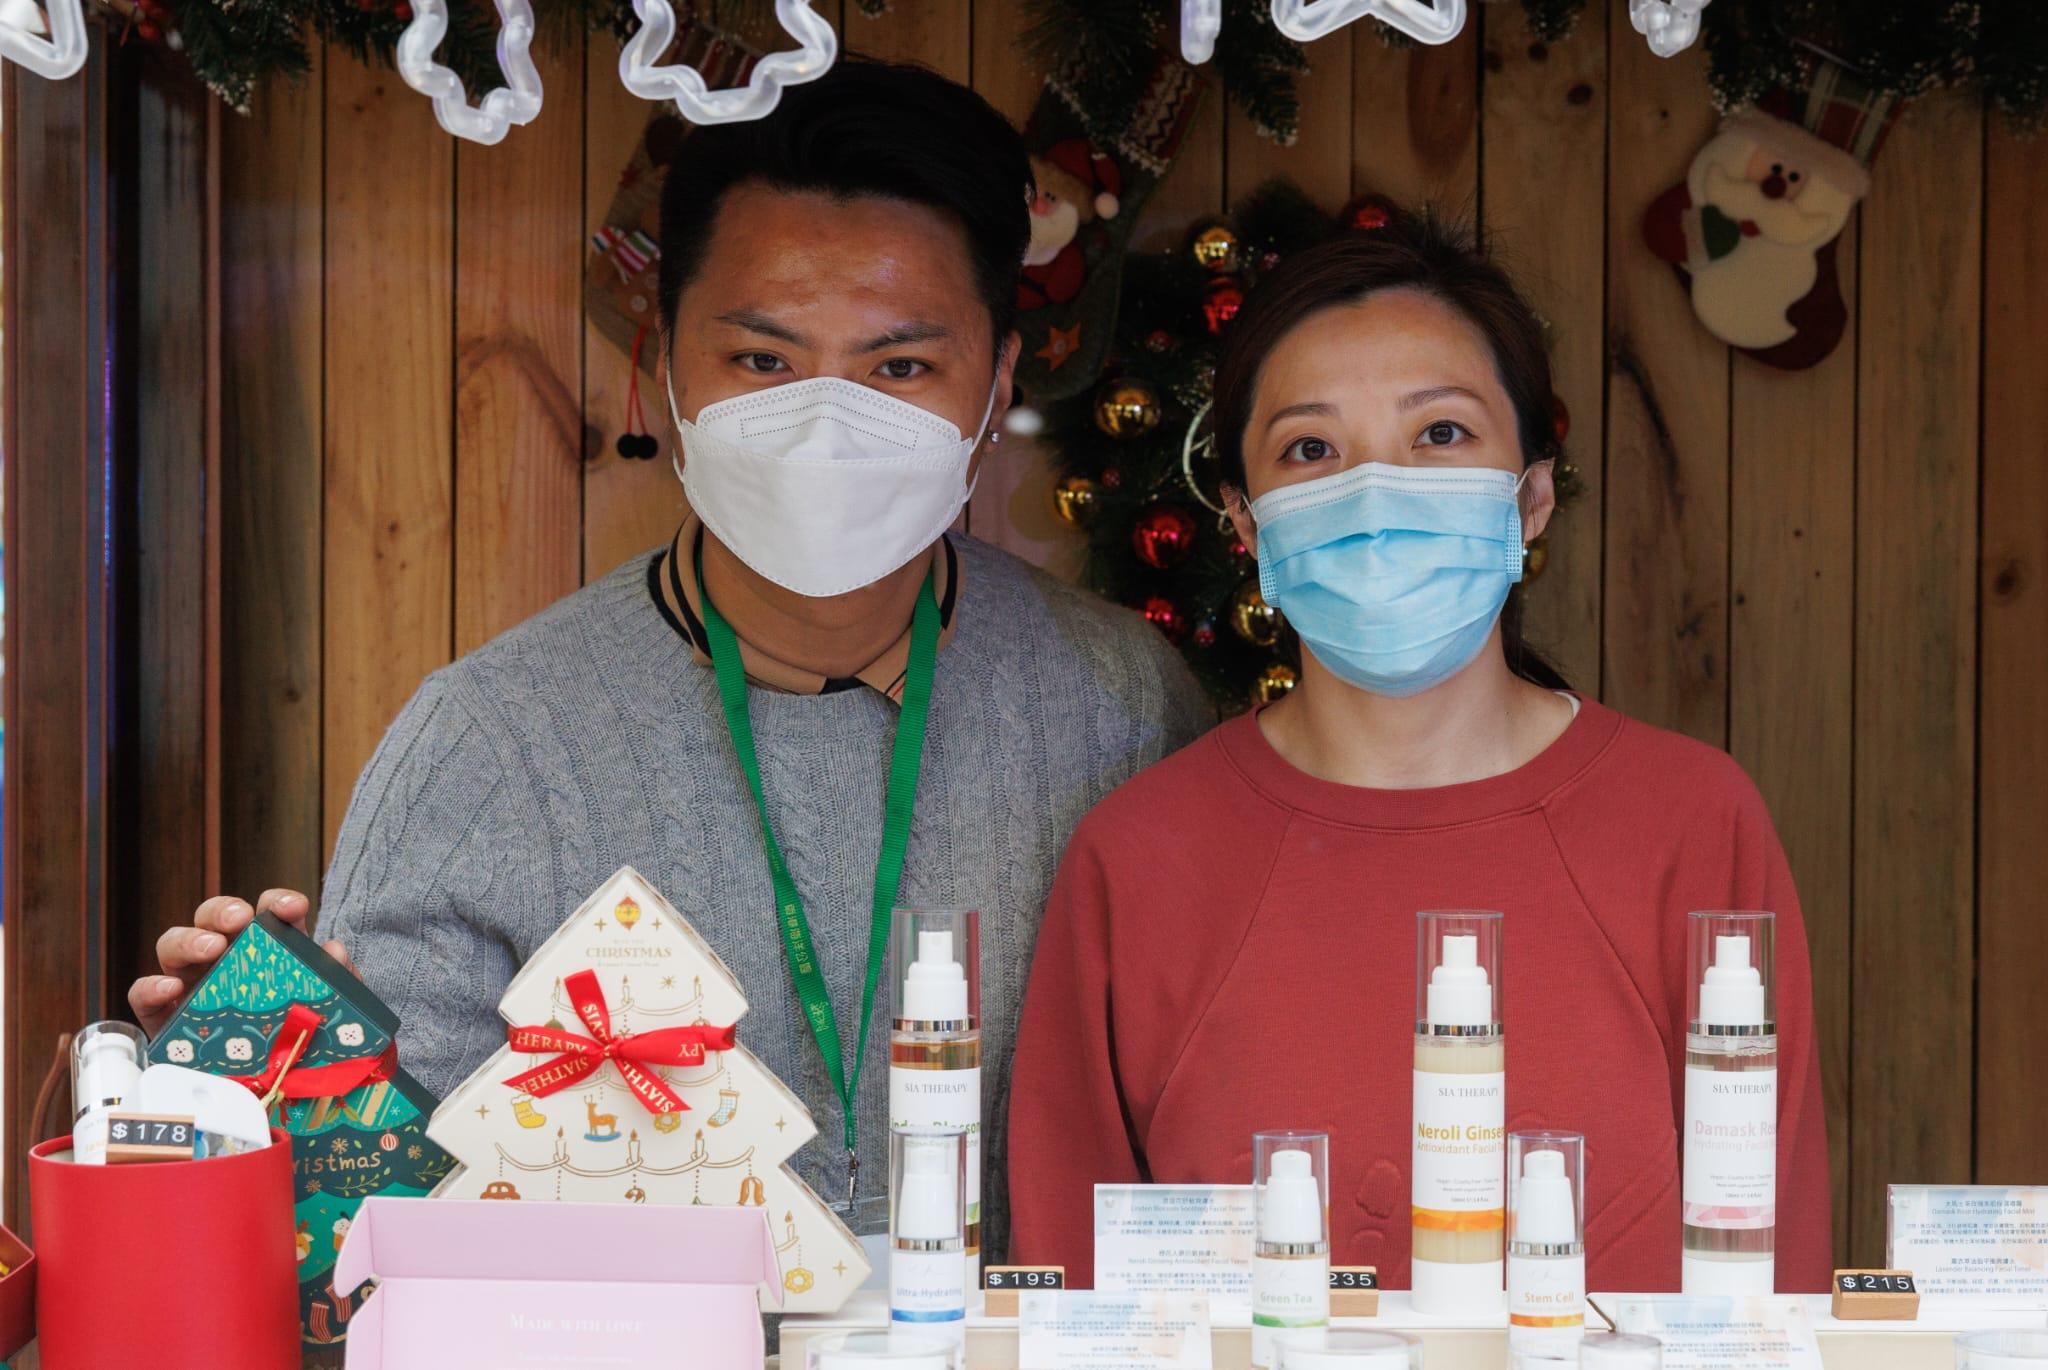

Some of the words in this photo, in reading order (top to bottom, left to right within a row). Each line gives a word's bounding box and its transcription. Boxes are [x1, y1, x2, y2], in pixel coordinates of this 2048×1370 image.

[585, 946, 672, 958] CHRISTMAS
[905, 1083, 919, 1093] SIA
[922, 1083, 968, 1094] THERAPY
[1438, 1087, 1454, 1097] SIA
[1458, 1087, 1498, 1097] THERAPY
[1713, 1083, 1729, 1094] SIA
[1733, 1083, 1772, 1094] THERAPY
[111, 1122, 186, 1143] $178
[1418, 1122, 1460, 1141] Neroli
[1695, 1120, 1756, 1137] Damask
[1417, 1141, 1469, 1154] Antioxidant
[988, 1272, 1057, 1287] $195
[1842, 1275, 1910, 1291] $215
[1260, 1292, 1290, 1305] Green
[1295, 1293, 1313, 1305] Tea
[1525, 1291, 1553, 1304] Stem
[1555, 1290, 1575, 1303] Cell
